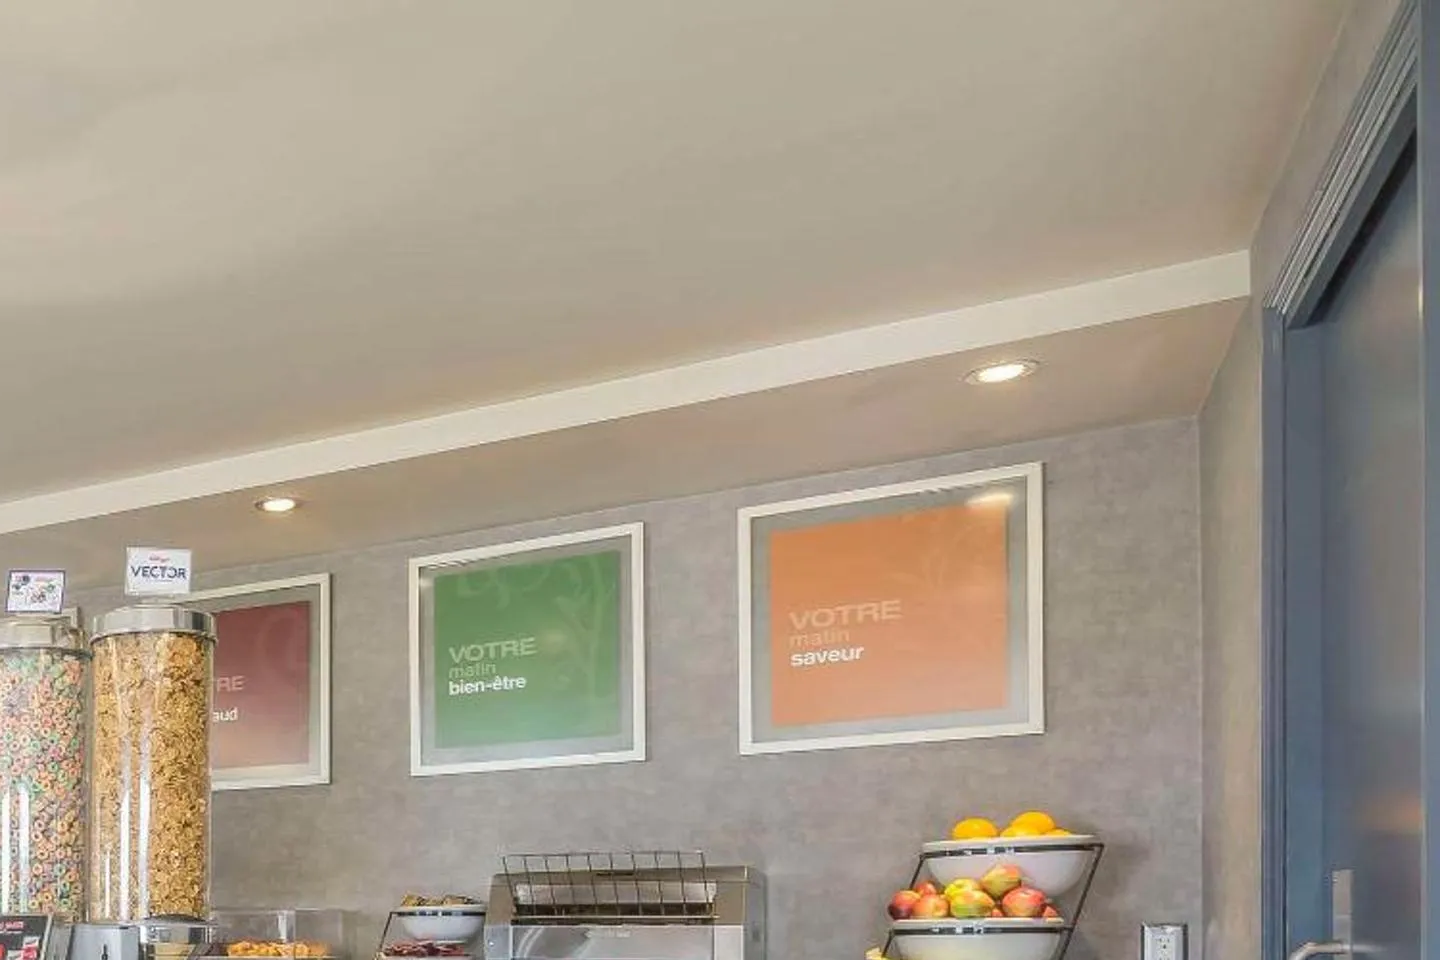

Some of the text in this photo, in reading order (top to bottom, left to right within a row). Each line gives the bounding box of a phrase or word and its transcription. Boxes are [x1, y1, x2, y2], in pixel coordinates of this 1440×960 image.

[130, 565, 187, 580] VECTOR
[788, 599, 903, 630] VOTRE
[789, 628, 850, 648] matin
[448, 637, 538, 664] VOTRE
[790, 646, 865, 667] saveur
[448, 662, 497, 679] matin
[448, 675, 527, 696] bien-être
[212, 706, 239, 722] aud
